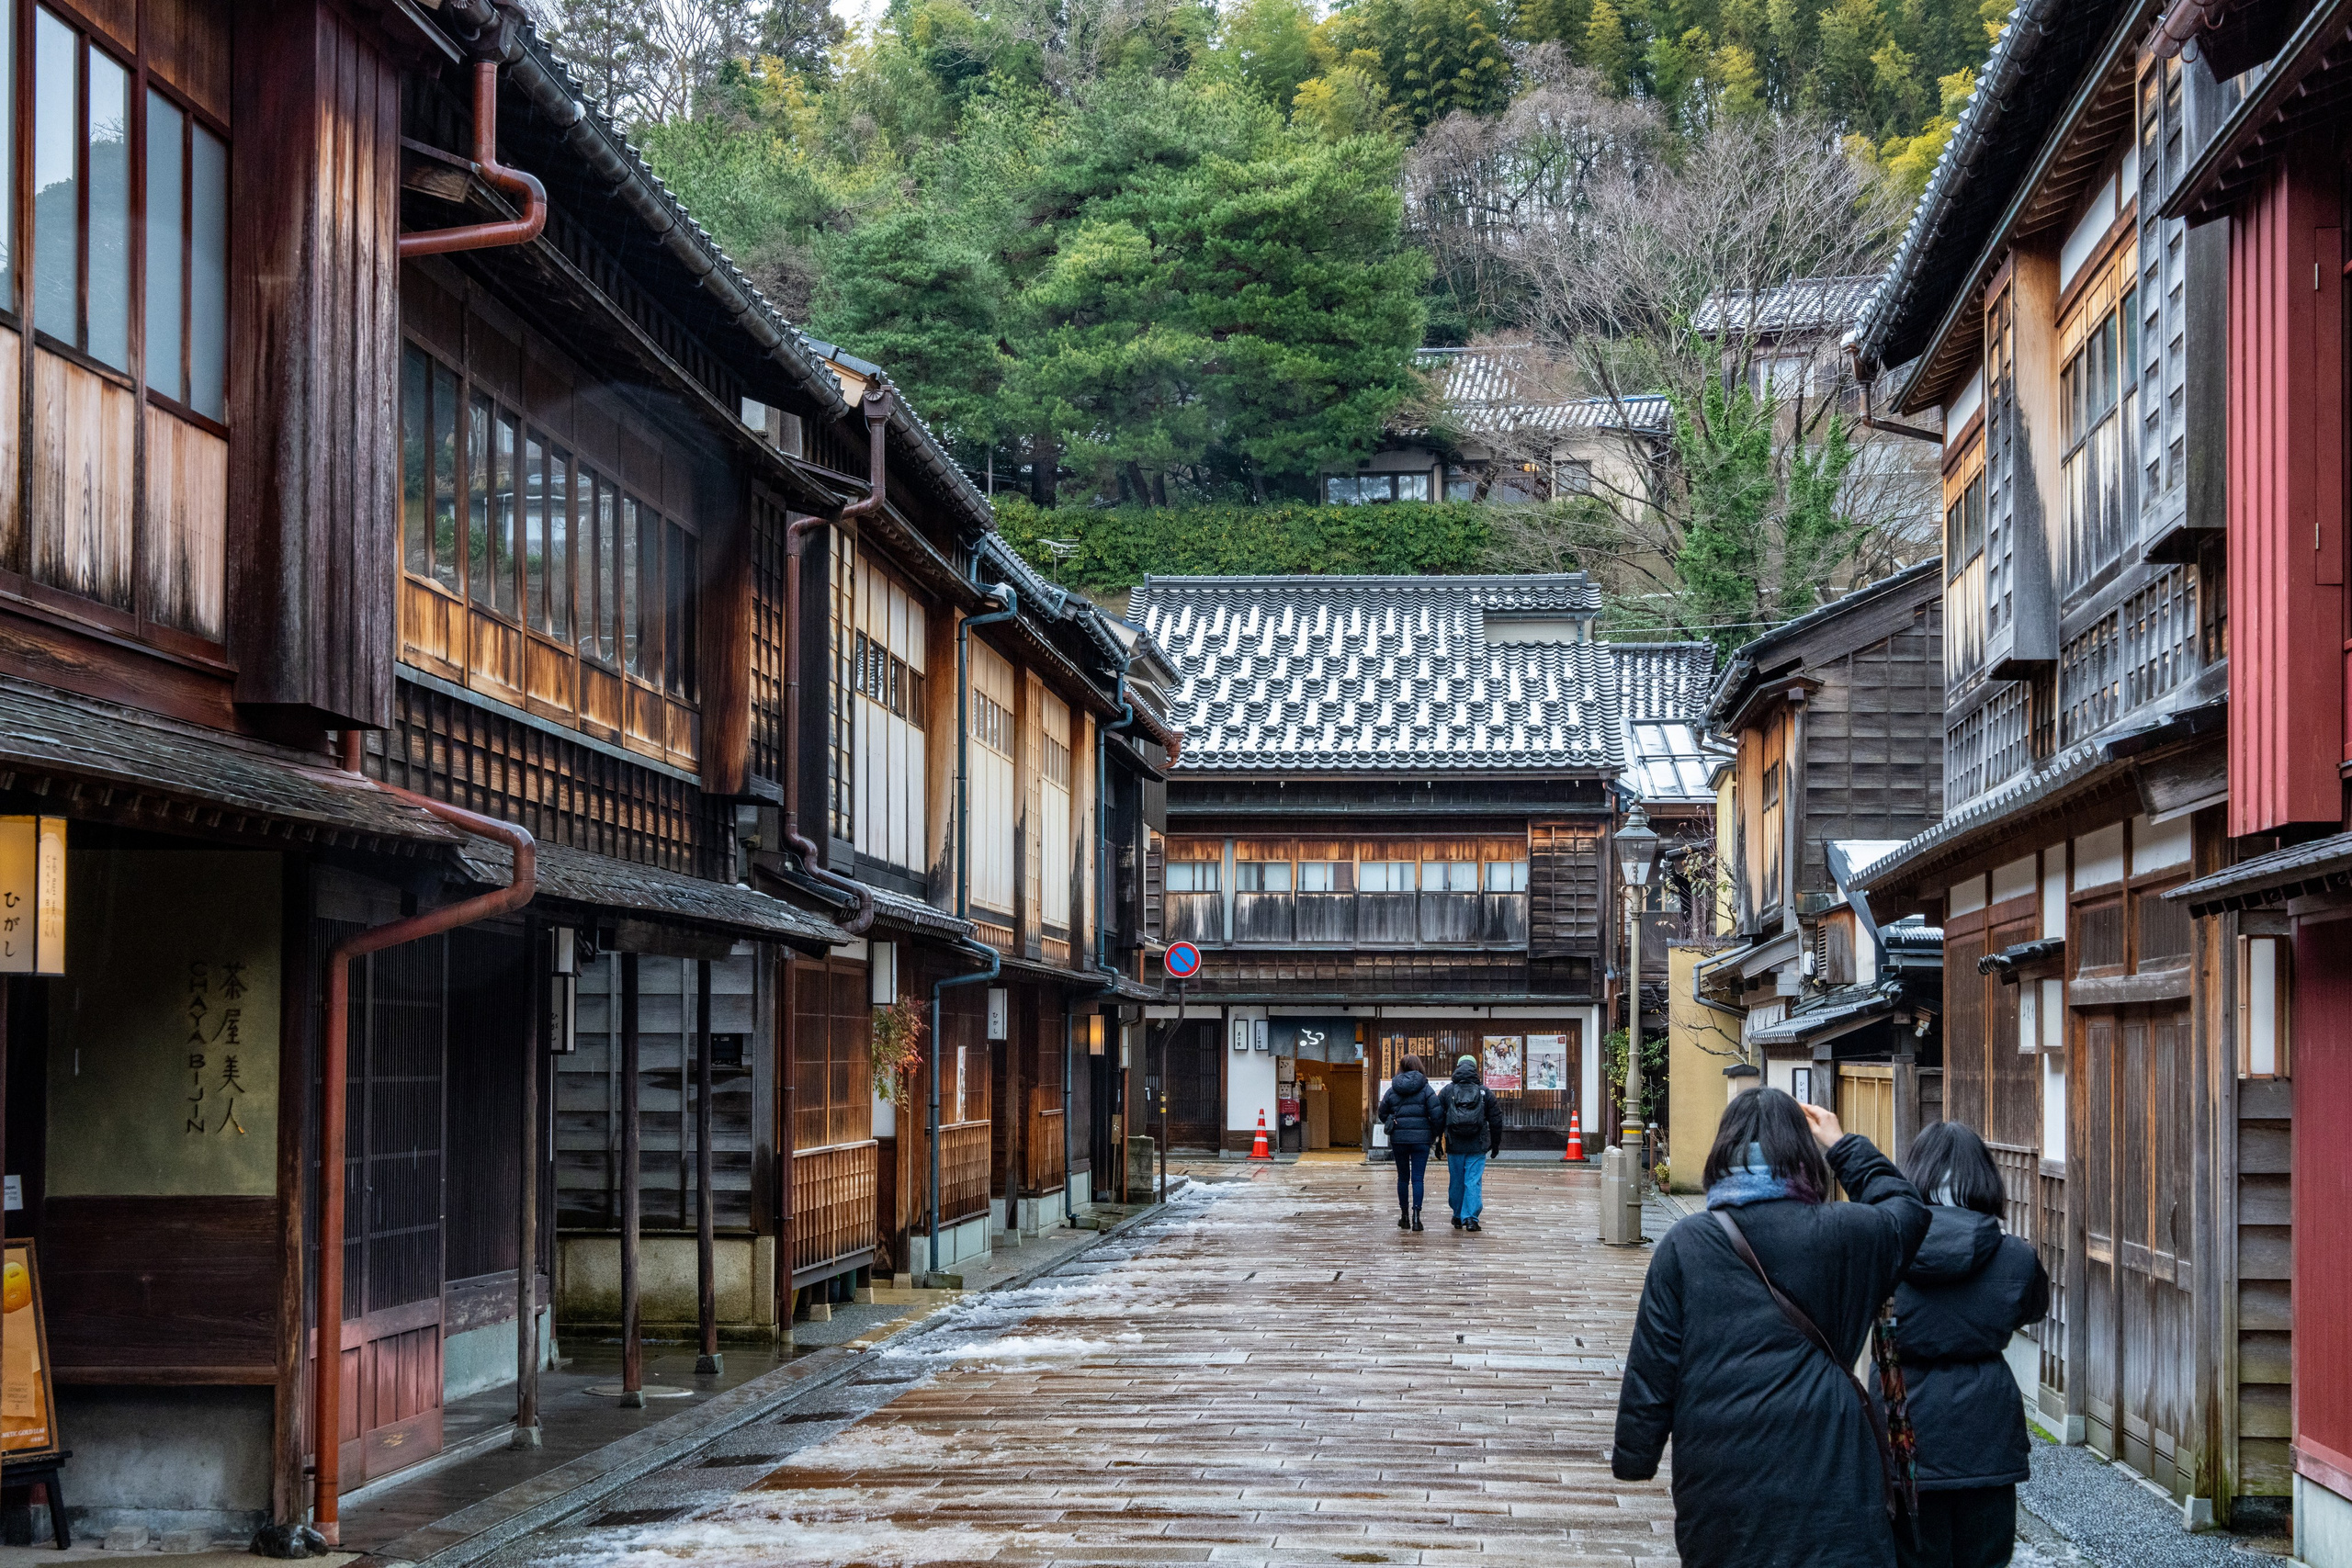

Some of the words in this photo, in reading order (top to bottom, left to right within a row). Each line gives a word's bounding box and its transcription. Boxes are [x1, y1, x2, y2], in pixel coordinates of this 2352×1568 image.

[4, 891, 21, 957] ひがし
[187, 961, 208, 1044] CHAYA
[1299, 1028, 1325, 1046] ふ
[212, 962, 247, 1134] 茶屋美人
[187, 1054, 206, 1134] BIJIN
